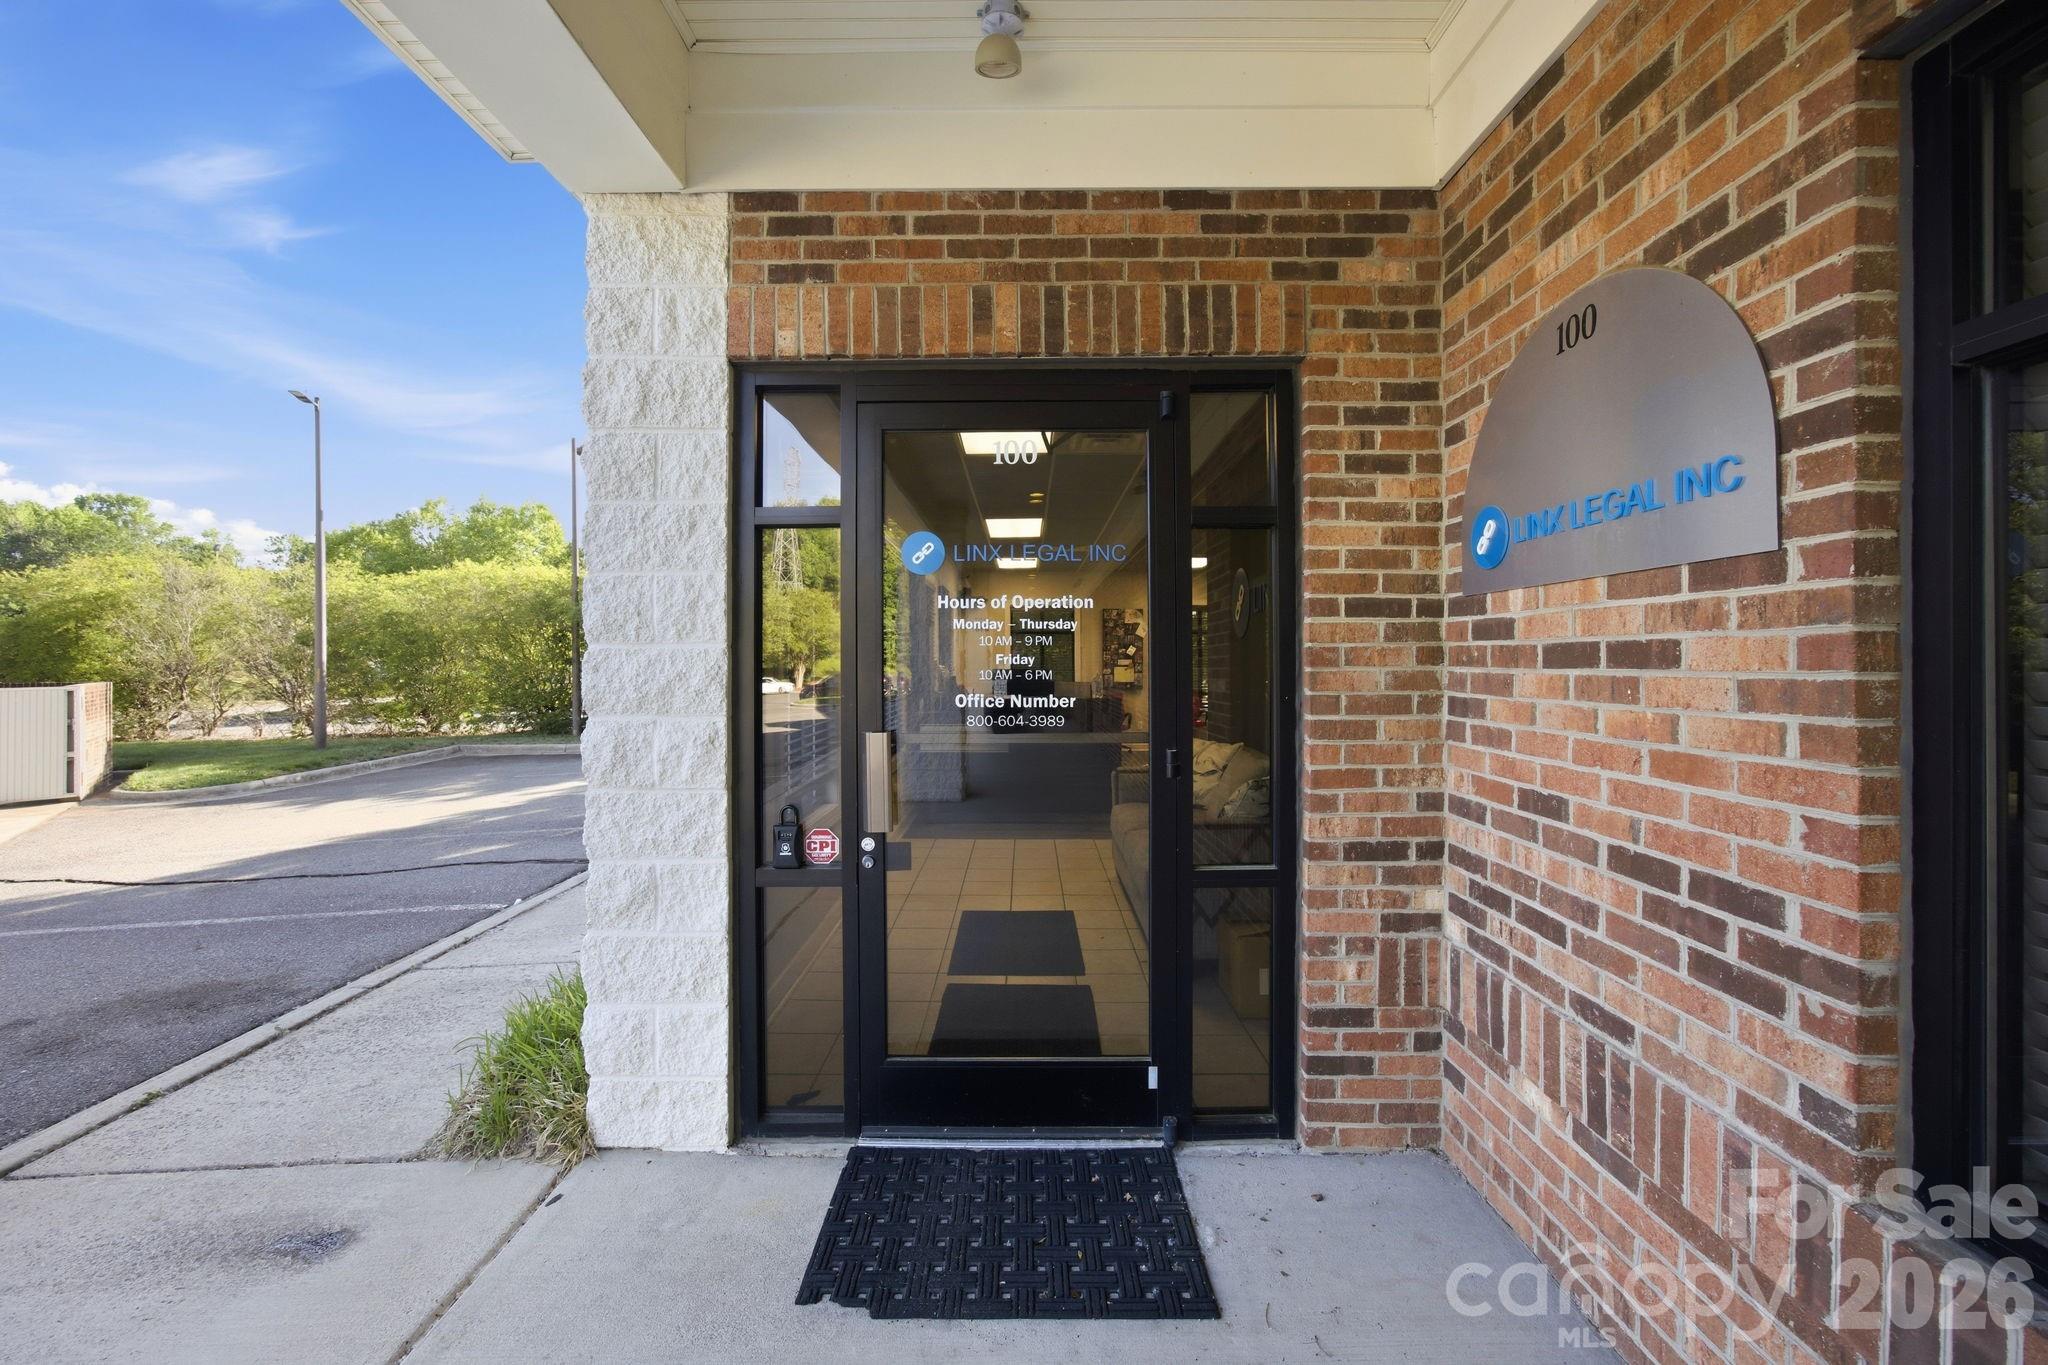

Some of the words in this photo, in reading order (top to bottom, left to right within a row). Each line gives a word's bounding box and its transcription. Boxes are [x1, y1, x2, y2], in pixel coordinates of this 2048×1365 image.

[1556, 303, 1597, 356] 100
[993, 440, 1038, 465] 100
[1513, 504, 1565, 544] LINX
[1570, 477, 1666, 529] LEGAL
[1673, 454, 1745, 505] INC
[953, 544, 1002, 562] LINX
[1010, 544, 1084, 562] LEGAL
[1089, 544, 1127, 562] INC
[937, 595, 986, 609] Hours
[991, 595, 1007, 609] of
[1012, 595, 1094, 611] Operation
[953, 618, 1004, 632] Monday
[1020, 618, 1078, 632] Thursday
[979, 636, 992, 646] 10
[995, 636, 1012, 646] AM
[1025, 636, 1032, 646] 9
[1035, 636, 1053, 646] PM
[995, 654, 1035, 667] Friday
[979, 670, 992, 680] 10
[995, 670, 1012, 680] AM
[1025, 670, 1032, 680] 6
[1035, 670, 1053, 680] PM
[955, 694, 1005, 709] Office
[1010, 694, 1076, 709] Number
[966, 715, 1065, 727] 800-604-3989
[806, 840, 836, 851] CPI
